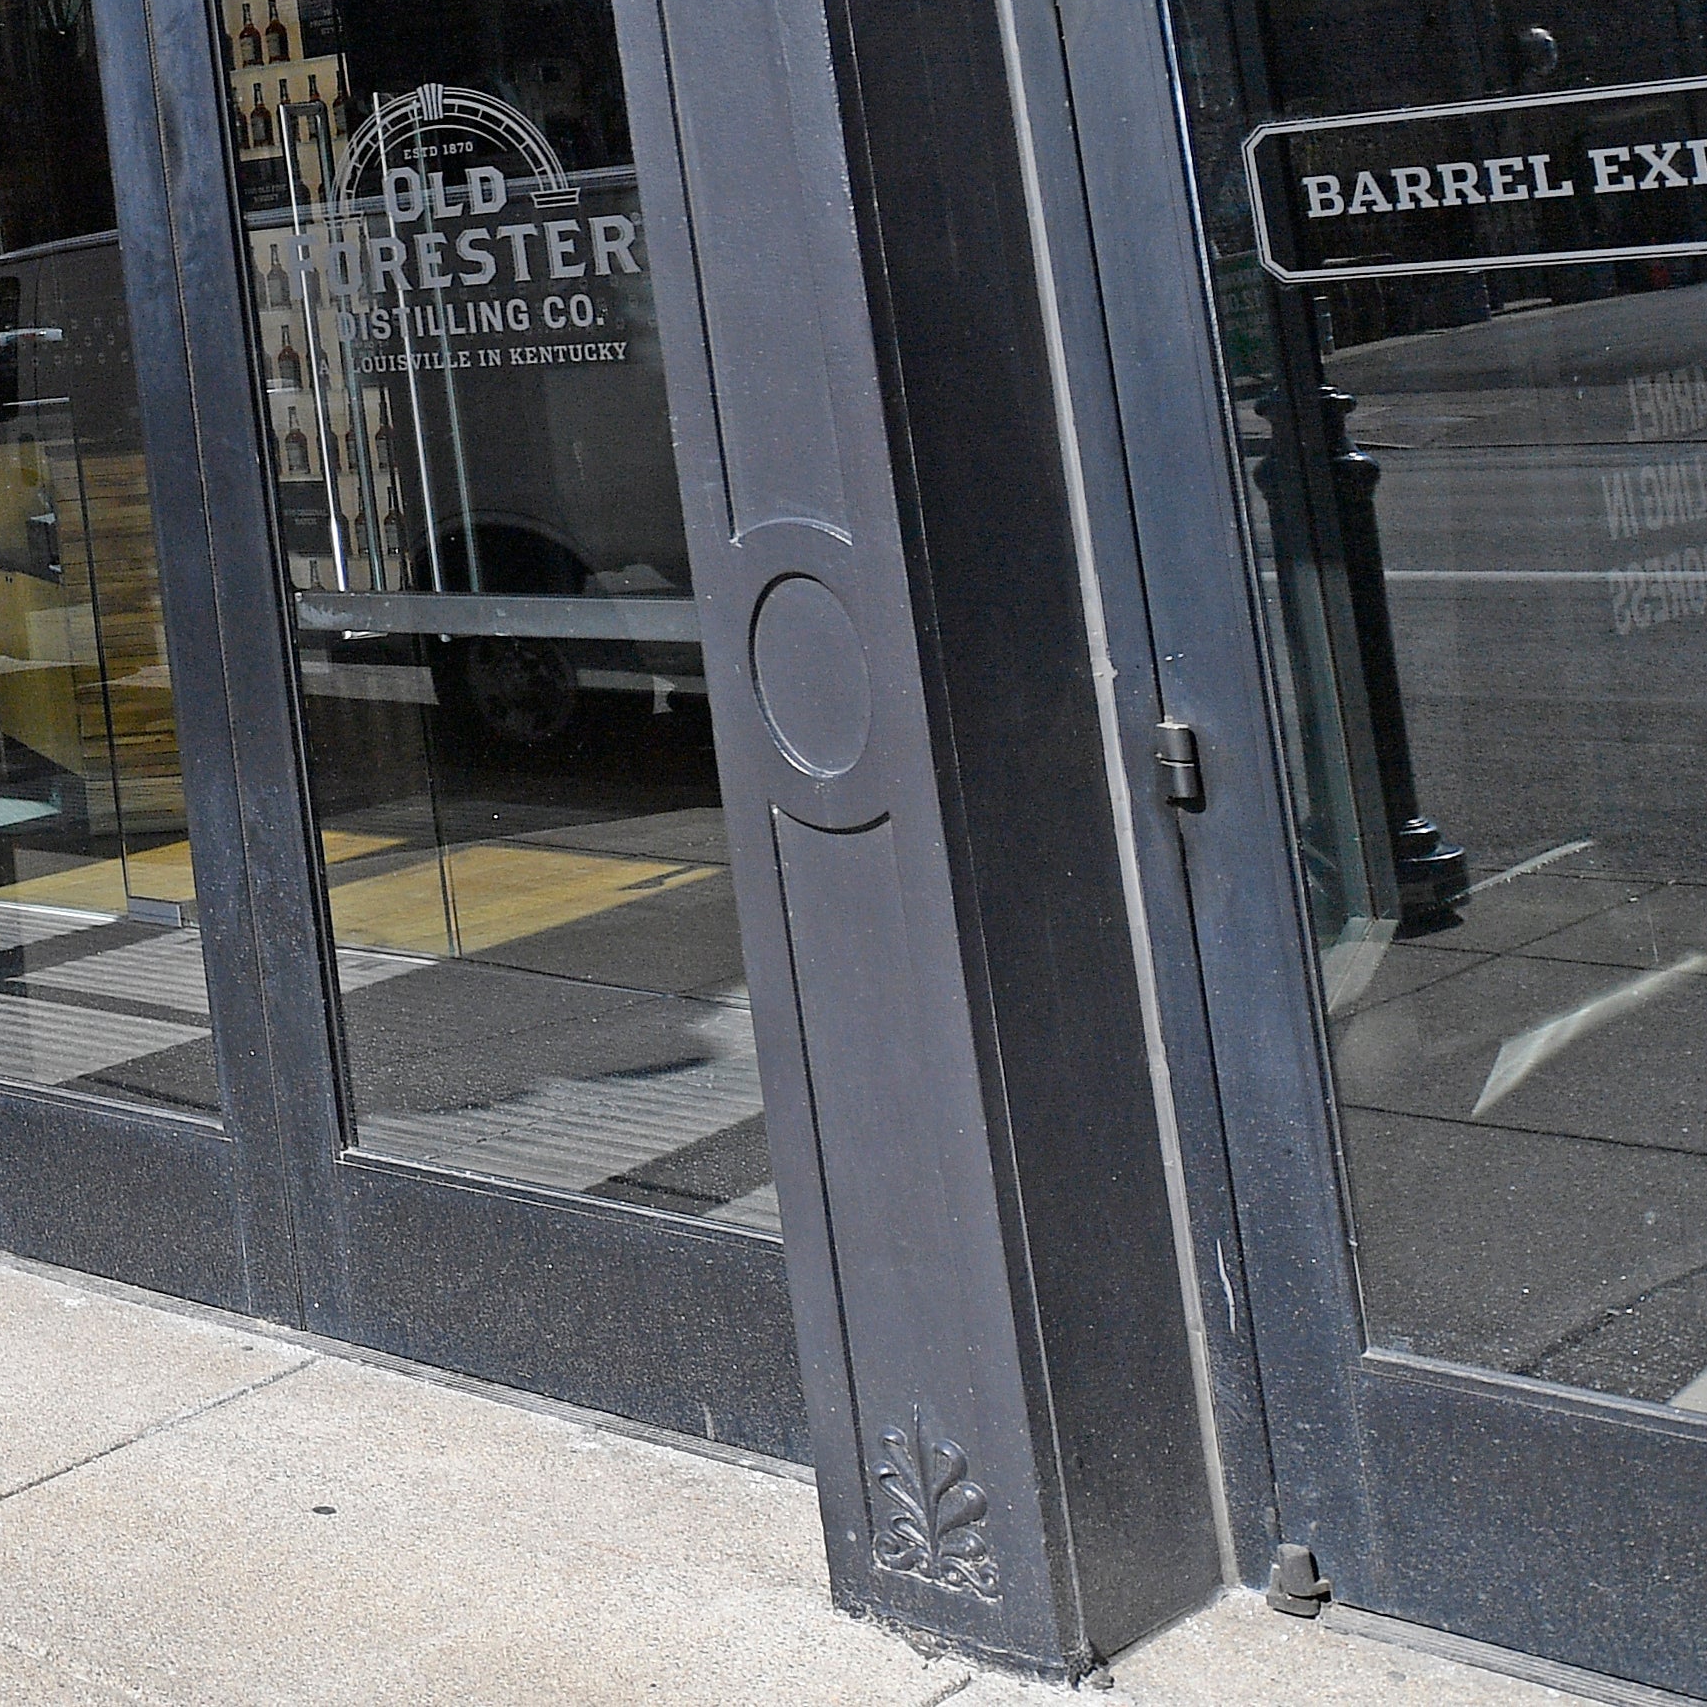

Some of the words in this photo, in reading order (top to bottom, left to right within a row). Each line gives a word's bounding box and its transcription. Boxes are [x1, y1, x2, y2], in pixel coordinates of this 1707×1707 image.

[403, 145, 438, 160] ESTD
[442, 141, 474, 156] 1870
[385, 165, 508, 223] OLD
[1303, 154, 1575, 219] BARREL
[284, 213, 642, 299] FORESTER
[336, 298, 531, 342] DISTILLING
[542, 293, 604, 331] CO.
[351, 351, 472, 375] LOUISVILLE
[479, 350, 502, 366] IN
[510, 341, 628, 366] KENTUCKY
